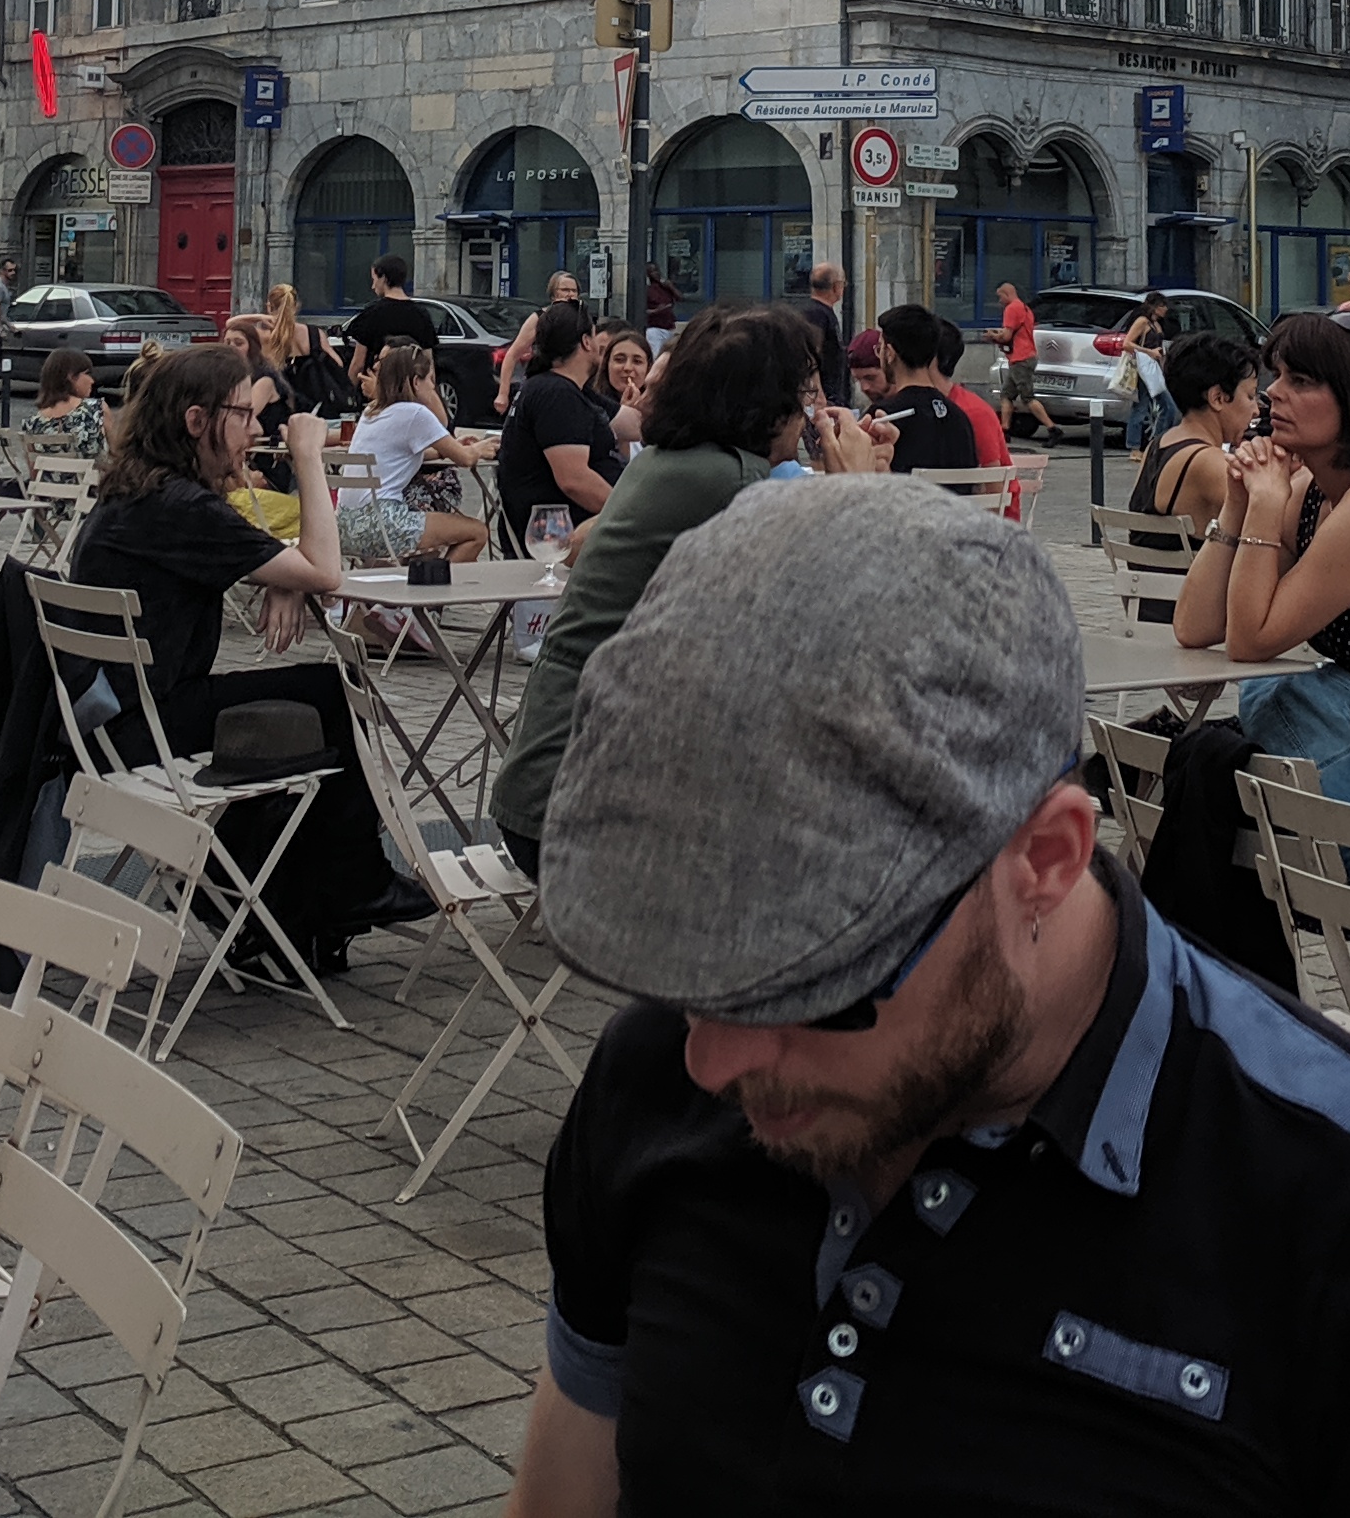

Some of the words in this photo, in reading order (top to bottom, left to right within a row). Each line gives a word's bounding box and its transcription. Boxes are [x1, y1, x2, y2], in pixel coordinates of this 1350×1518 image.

[1118, 52, 1176, 72] BESANÇON
[1191, 60, 1238, 79] BATTANT
[880, 72, 931, 87] Condé
[755, 104, 810, 116] Résidence
[812, 103, 872, 115] Autonomie
[874, 102, 887, 114] Le
[889, 102, 934, 114] Marulaz
[864, 148, 888, 167] 3,5t
[496, 170, 516, 182] LA
[525, 167, 581, 181] POSTE
[49, 167, 107, 198] PRESSE
[855, 190, 899, 204] TRANSIT
